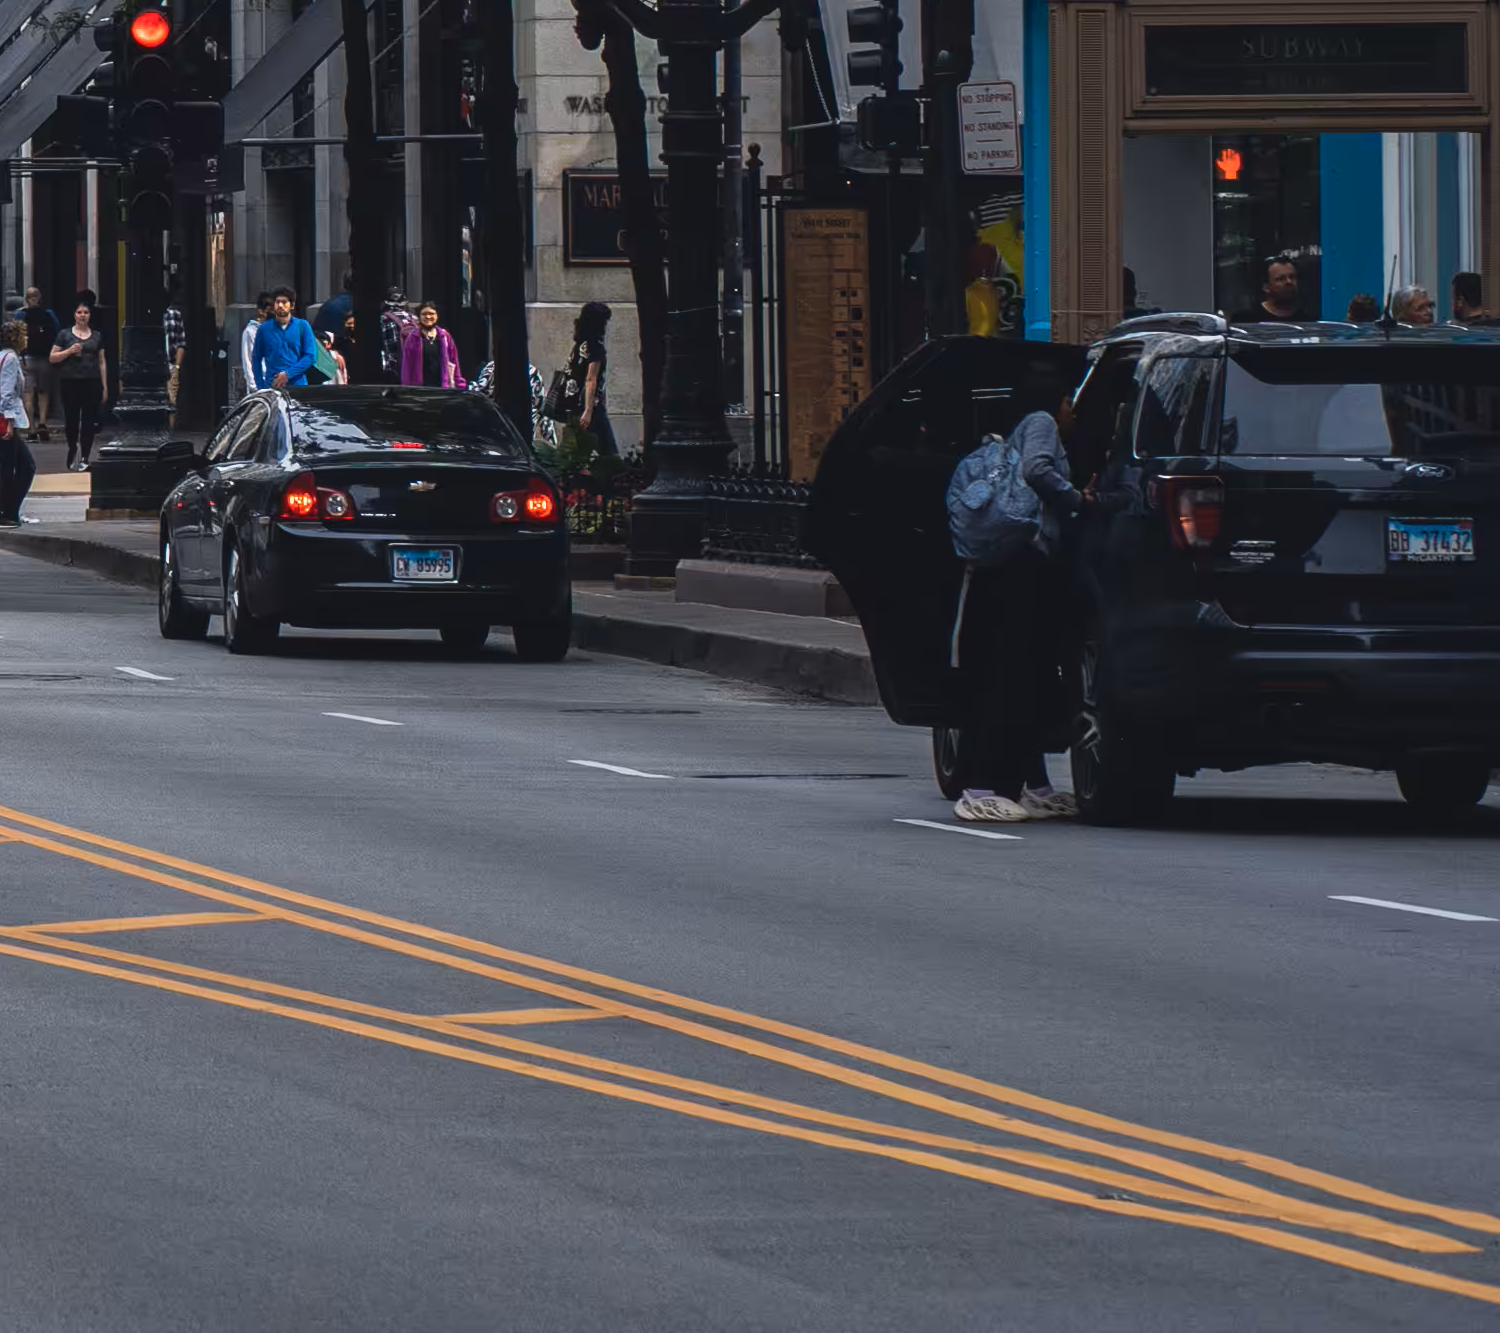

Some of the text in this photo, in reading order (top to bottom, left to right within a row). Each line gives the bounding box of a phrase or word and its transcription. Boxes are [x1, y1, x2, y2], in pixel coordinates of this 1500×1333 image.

[962, 93, 1012, 104] NO STOPPING
[964, 121, 1014, 132] NO STANDING
[967, 149, 1015, 161] NO PARKING
[1420, 529, 1472, 553] 37432
[416, 557, 452, 574] 85995
